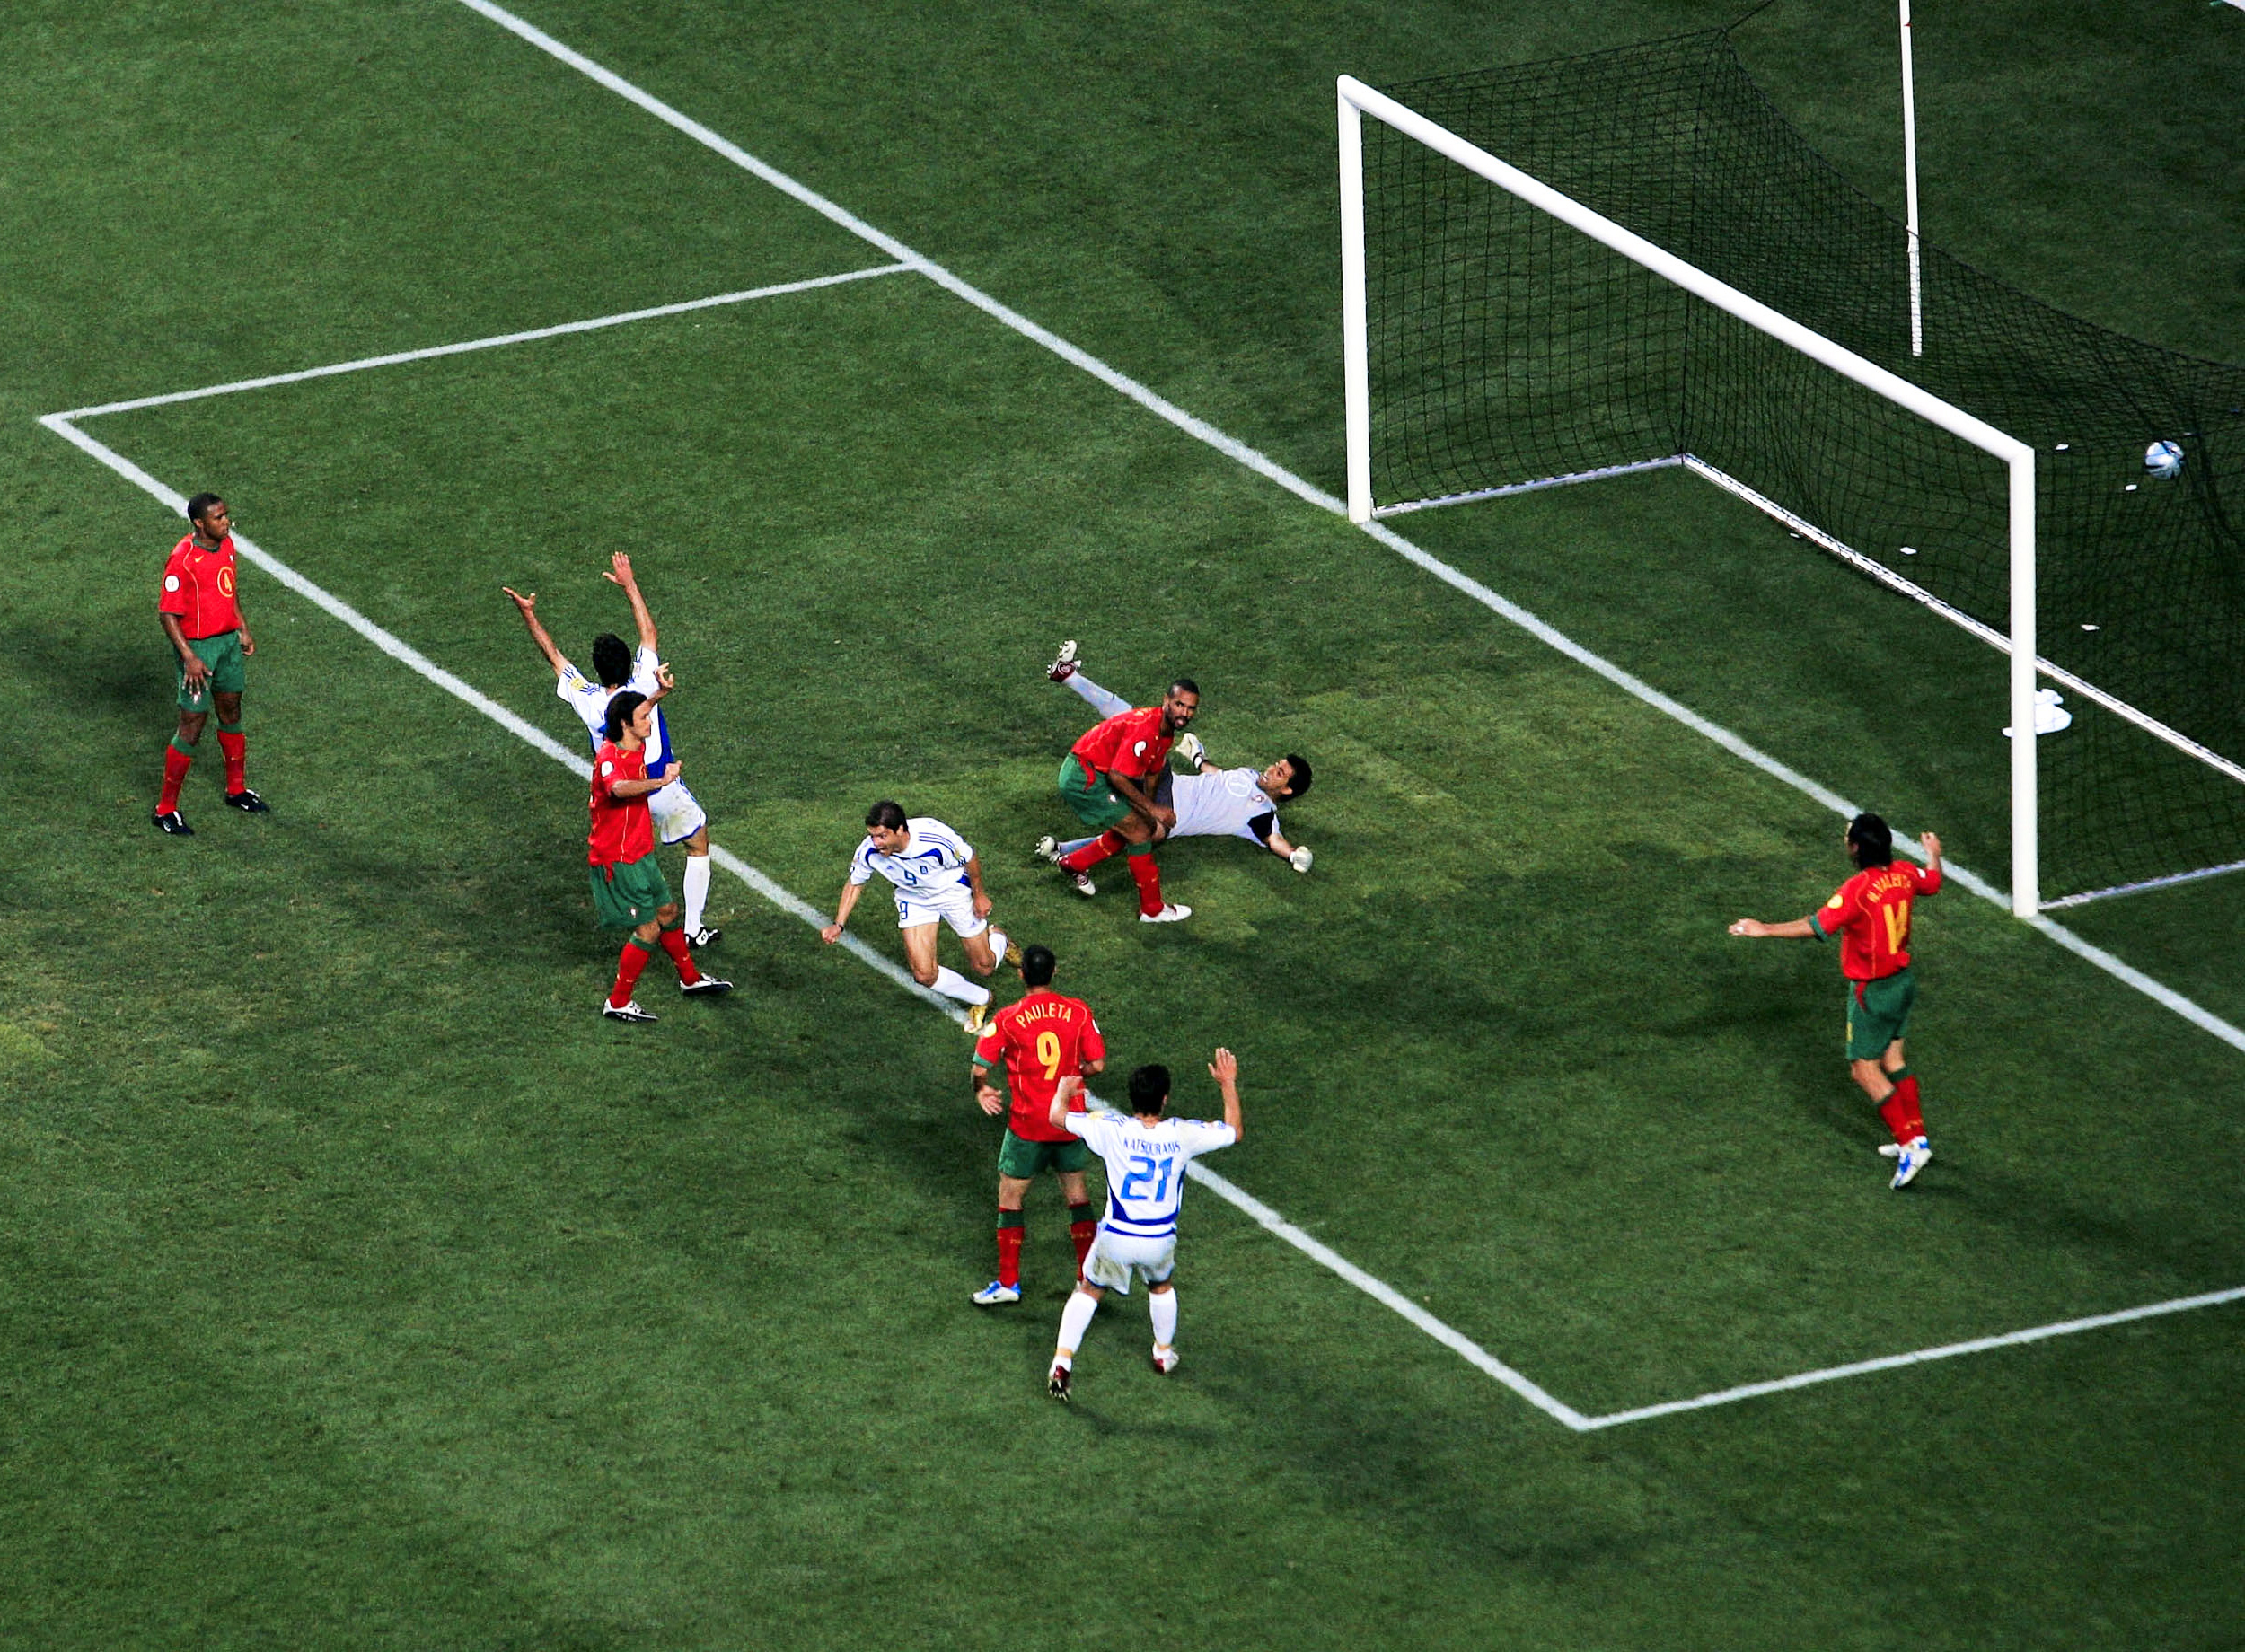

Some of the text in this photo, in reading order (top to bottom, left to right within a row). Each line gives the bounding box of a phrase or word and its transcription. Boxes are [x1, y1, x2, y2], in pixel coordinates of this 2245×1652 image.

[1015, 1002, 1072, 1028] PAULETA
[1036, 1031, 1061, 1081] 9
[1120, 1155, 1174, 1203] 21
